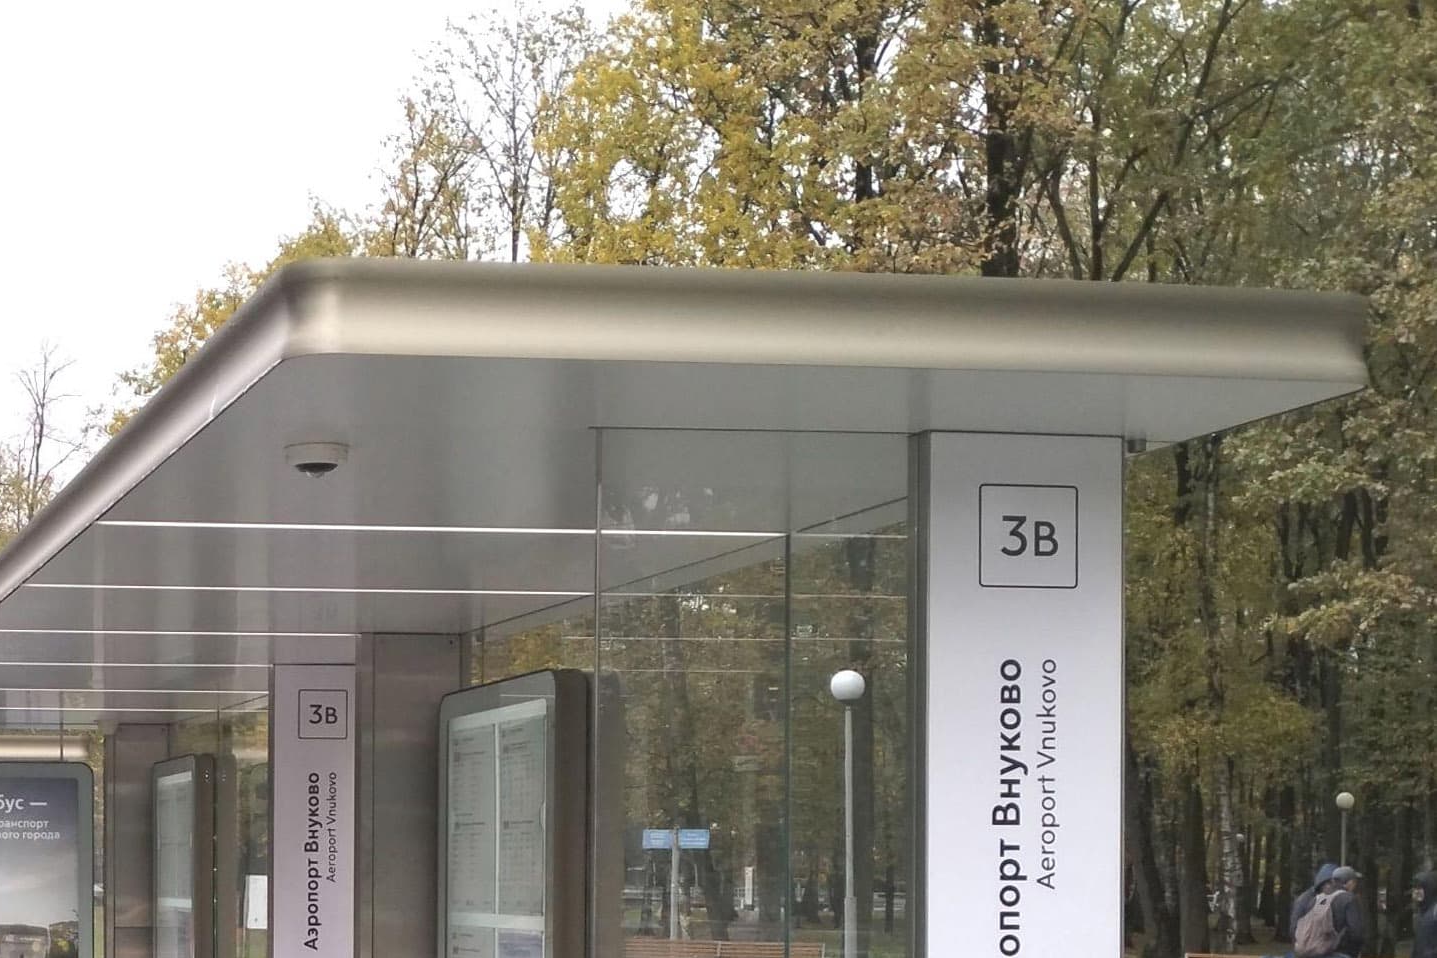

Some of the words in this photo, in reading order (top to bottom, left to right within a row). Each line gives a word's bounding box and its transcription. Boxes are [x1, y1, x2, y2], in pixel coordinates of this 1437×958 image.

[991, 658, 1029, 827] Внуково
[1035, 658, 1057, 769] Vnukovo
[22, 831, 60, 841] города
[304, 772, 323, 853] Внуково
[326, 771, 337, 825] Vnukovo
[1036, 775, 1060, 890] Aeroport
[326, 828, 338, 883] Aeroport
[303, 858, 322, 951] Аэропорт
